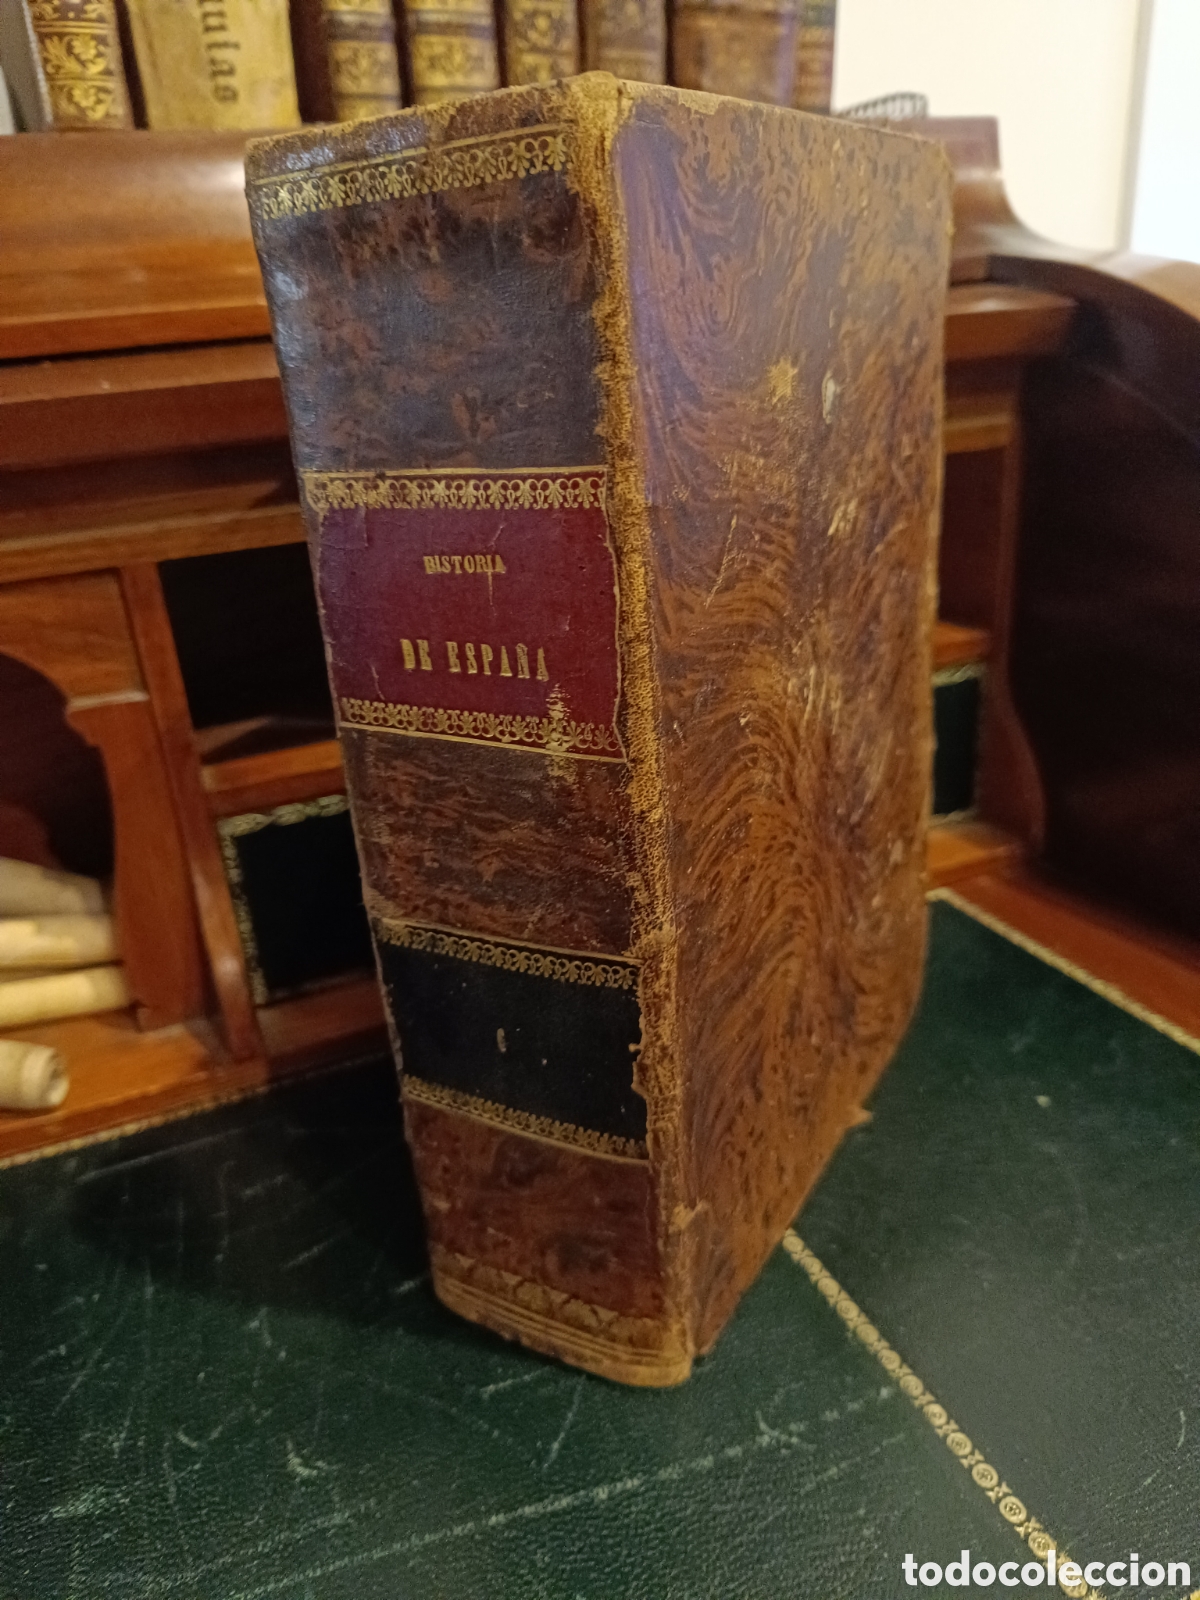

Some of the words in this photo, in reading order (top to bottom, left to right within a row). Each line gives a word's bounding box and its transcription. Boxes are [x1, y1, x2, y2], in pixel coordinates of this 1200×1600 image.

[423, 554, 507, 575] HISTORIA
[400, 638, 433, 671] DE
[446, 640, 549, 682] ESPAÑA
